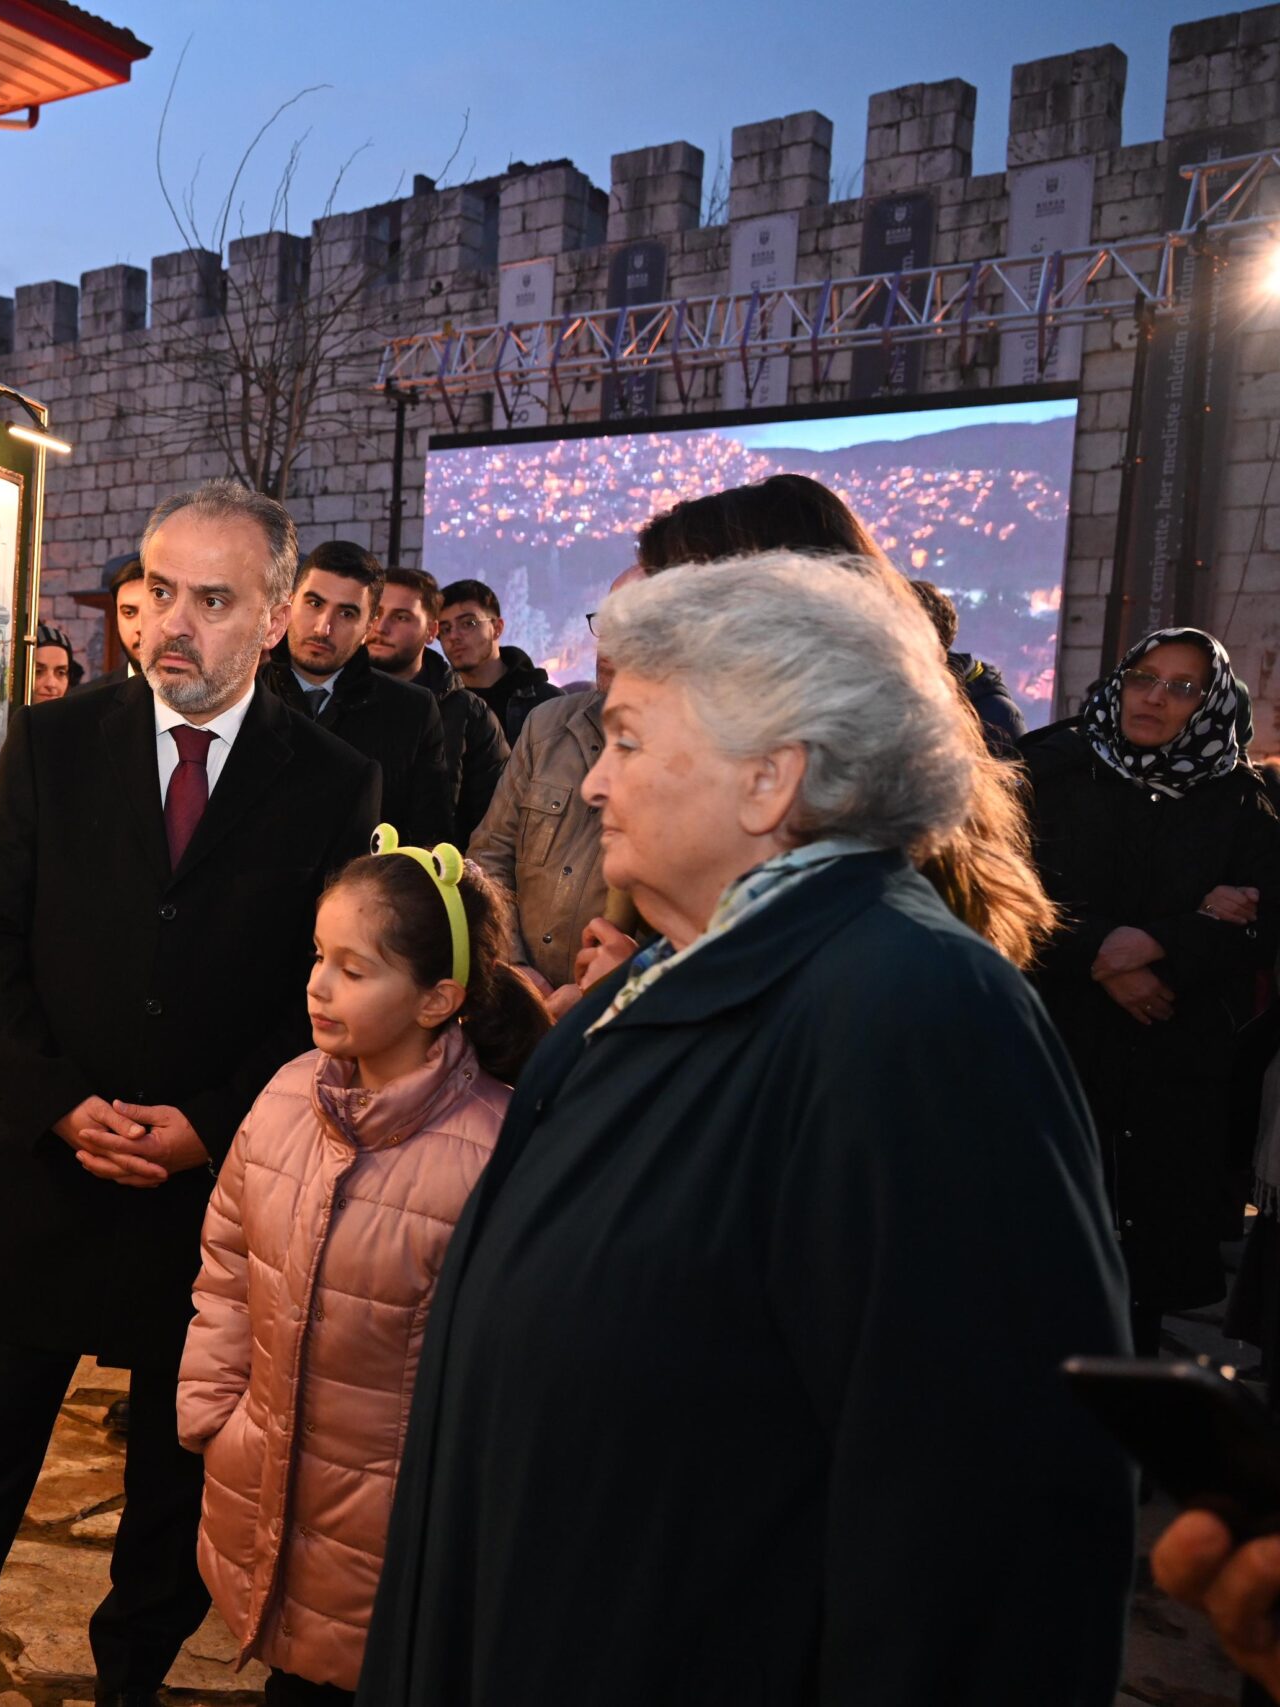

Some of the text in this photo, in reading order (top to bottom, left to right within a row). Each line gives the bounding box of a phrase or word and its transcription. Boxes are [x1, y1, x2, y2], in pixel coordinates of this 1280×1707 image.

[1164, 331, 1189, 398] inledim
[1159, 402, 1181, 475] mecliste
[1154, 479, 1173, 509] her
[1150, 513, 1172, 603] cemiyette,
